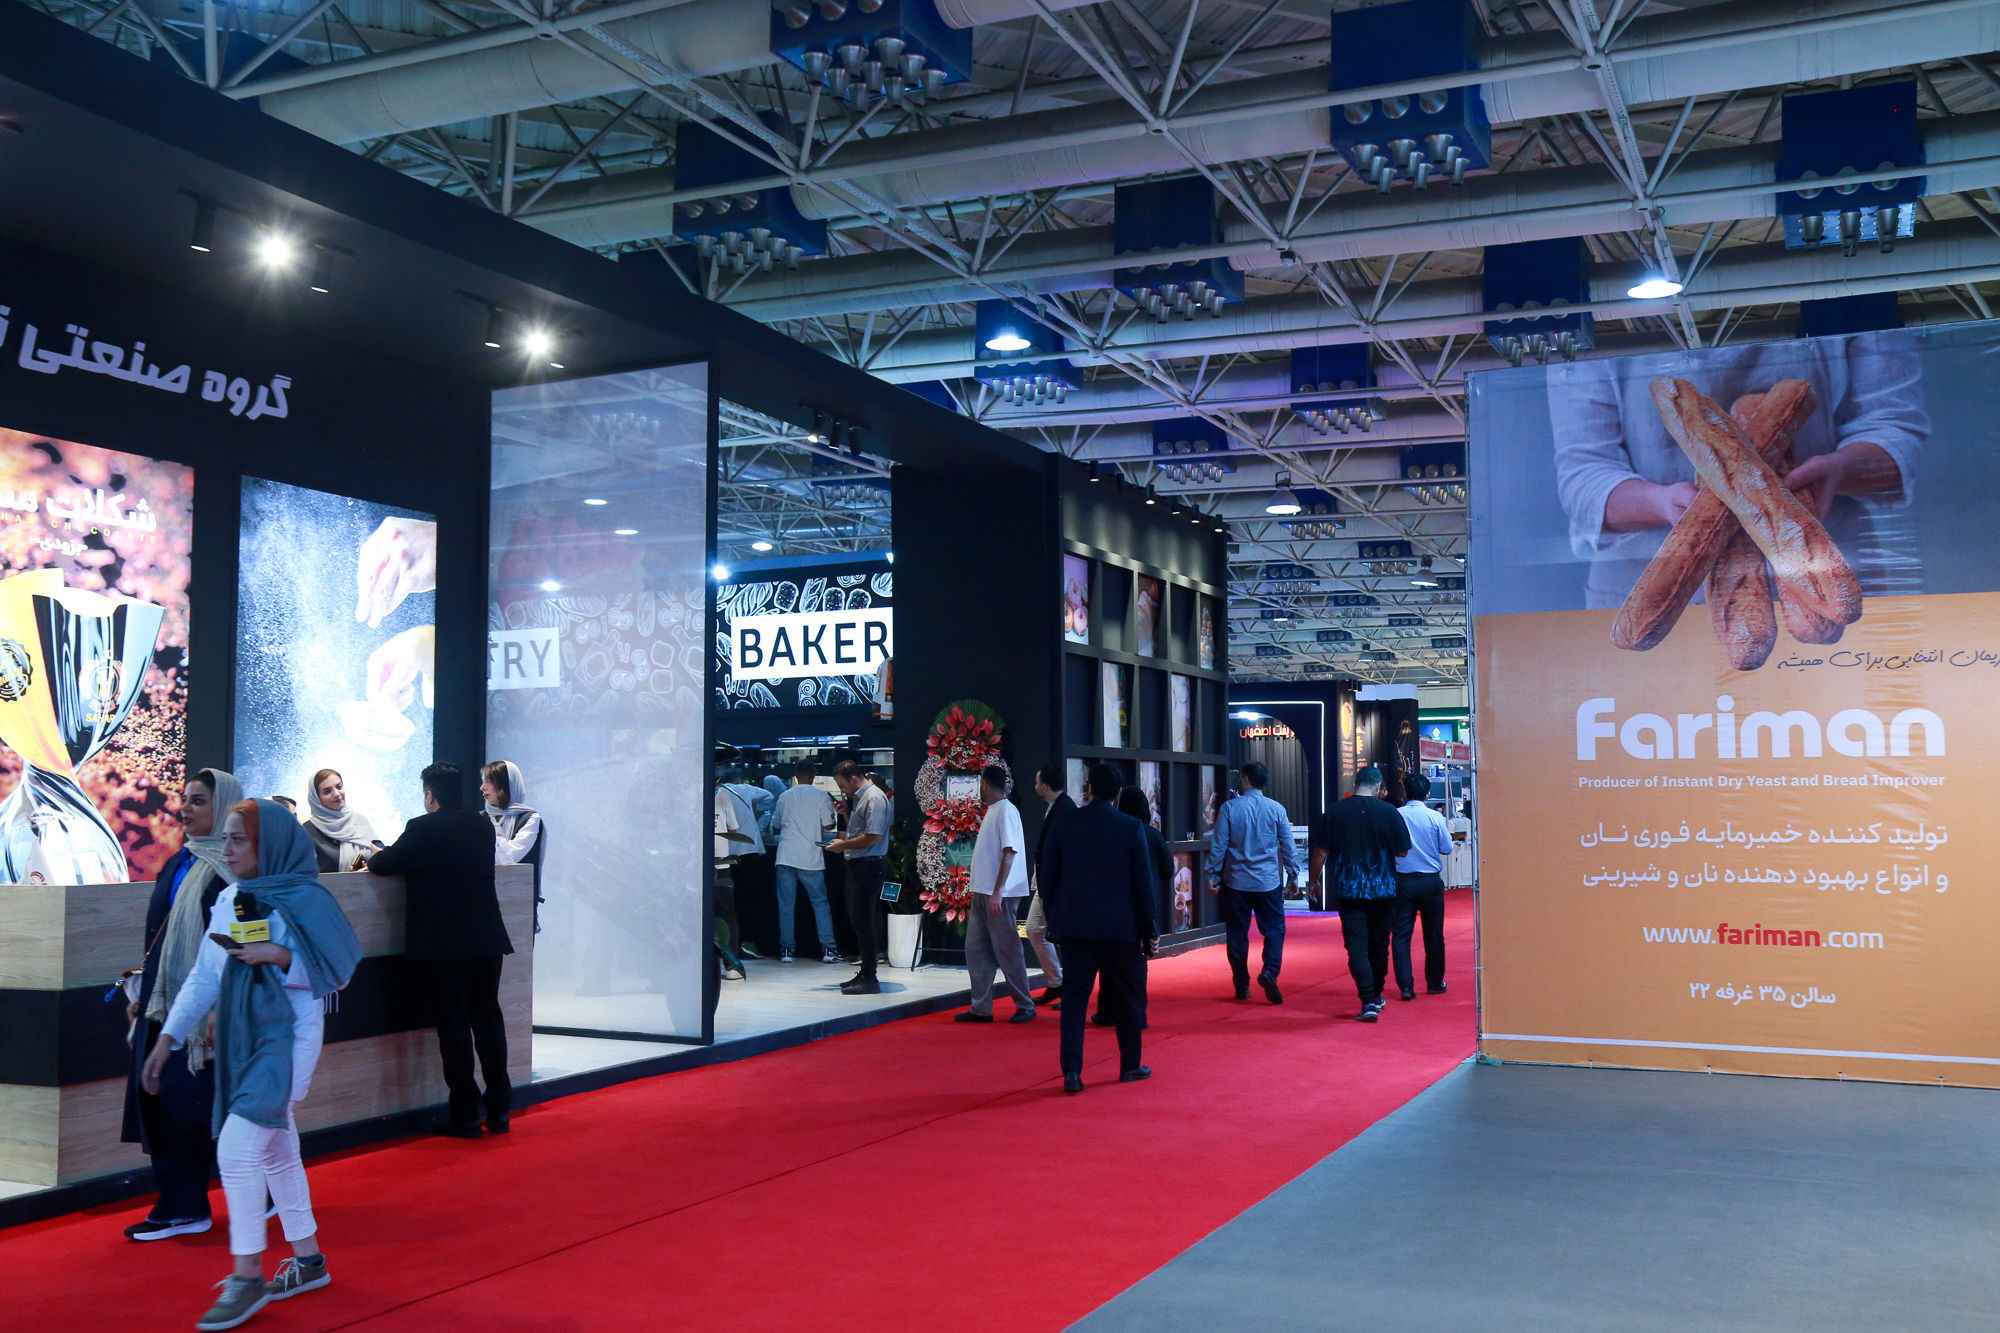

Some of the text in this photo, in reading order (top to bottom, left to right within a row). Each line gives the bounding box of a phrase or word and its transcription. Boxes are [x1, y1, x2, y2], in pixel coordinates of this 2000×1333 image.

[18, 323, 191, 394] صنعتی
[201, 369, 292, 421] گروه
[1829, 651, 1883, 671] برای
[1578, 773, 1945, 790] Producer of Instant Dry Yeast and Bread Improver
[1580, 820, 1949, 851] تولید کننده خمیرمایه فوری نان
[1583, 862, 1949, 895] و انواع بهبود دهنده نان و شیرینی
[1642, 923, 1885, 949] www.fariman.com
[1689, 982, 1837, 1009] سالن ۳۵ غرفه ۲۲
